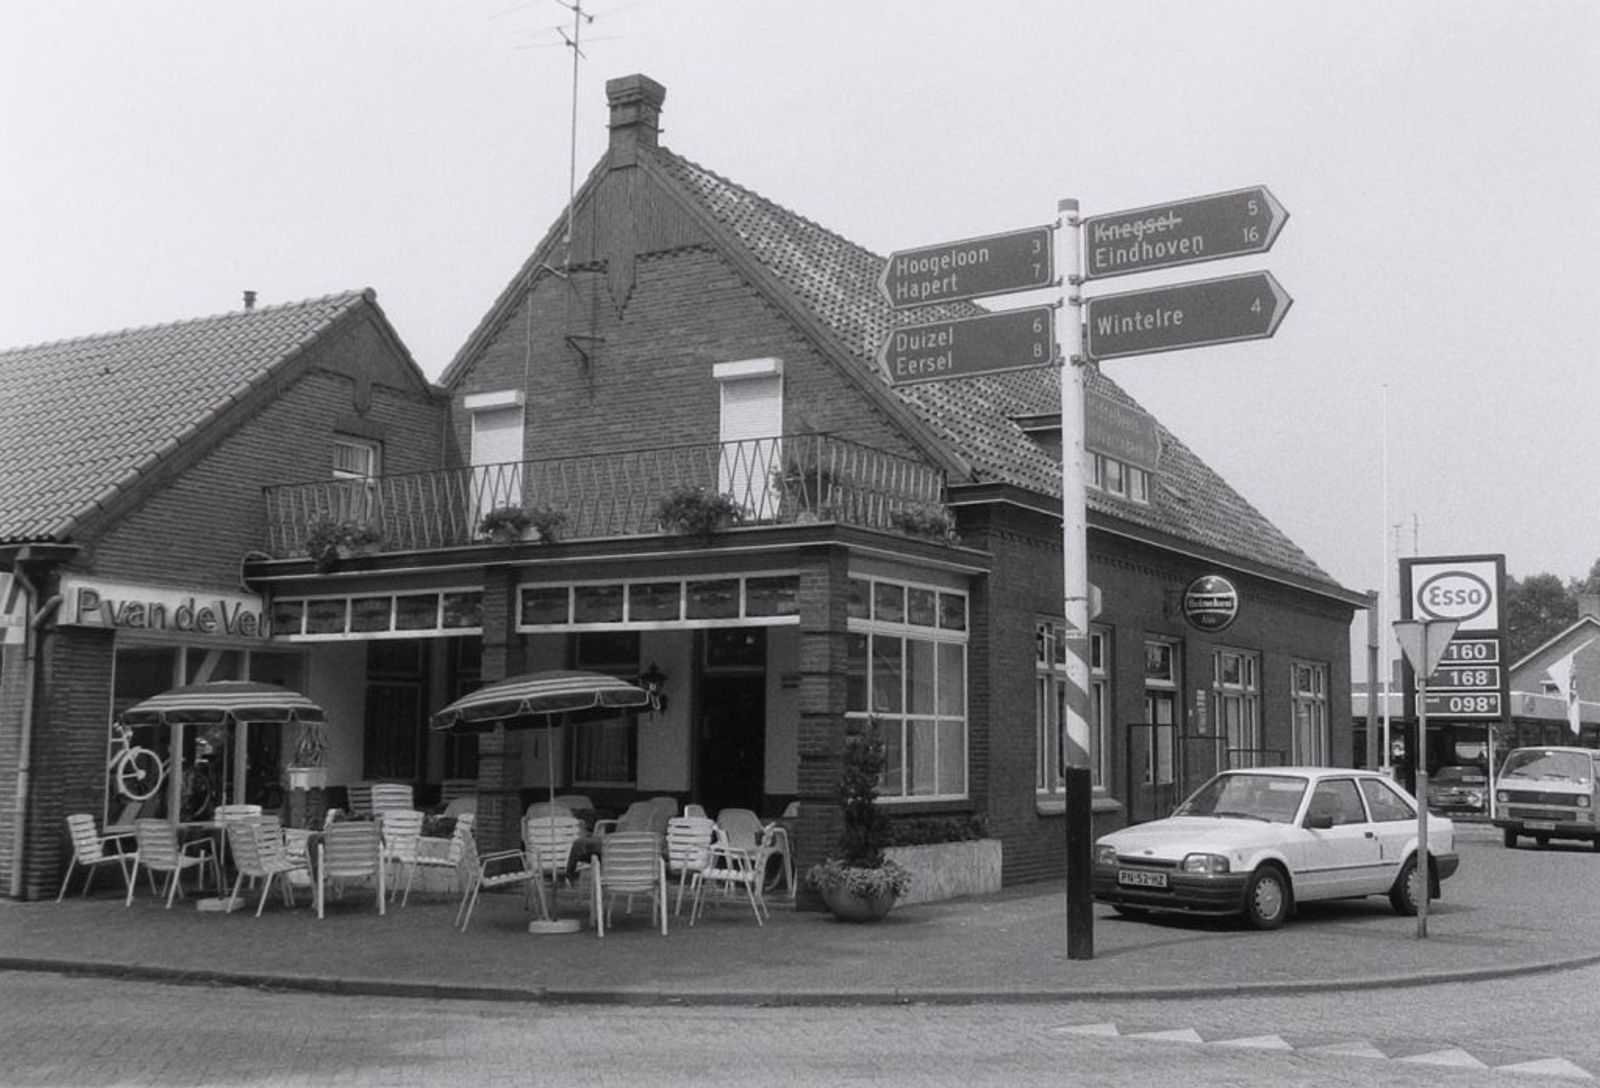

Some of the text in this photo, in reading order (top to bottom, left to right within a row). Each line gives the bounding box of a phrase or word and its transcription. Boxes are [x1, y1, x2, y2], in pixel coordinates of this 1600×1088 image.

[1094, 200, 1258, 243] Knegsel 5
[896, 239, 1041, 277] Hoogeloon 3
[1095, 227, 1259, 268] Eindhoven 16
[896, 264, 1041, 300] Hapert 7
[1097, 297, 1262, 336] Wintelre 4
[896, 318, 1042, 352] Duizel 6
[896, 343, 1042, 376] Eersel 8
[174, 598, 217, 634] de
[1449, 643, 1487, 660] 160
[1450, 670, 1488, 686] 168
